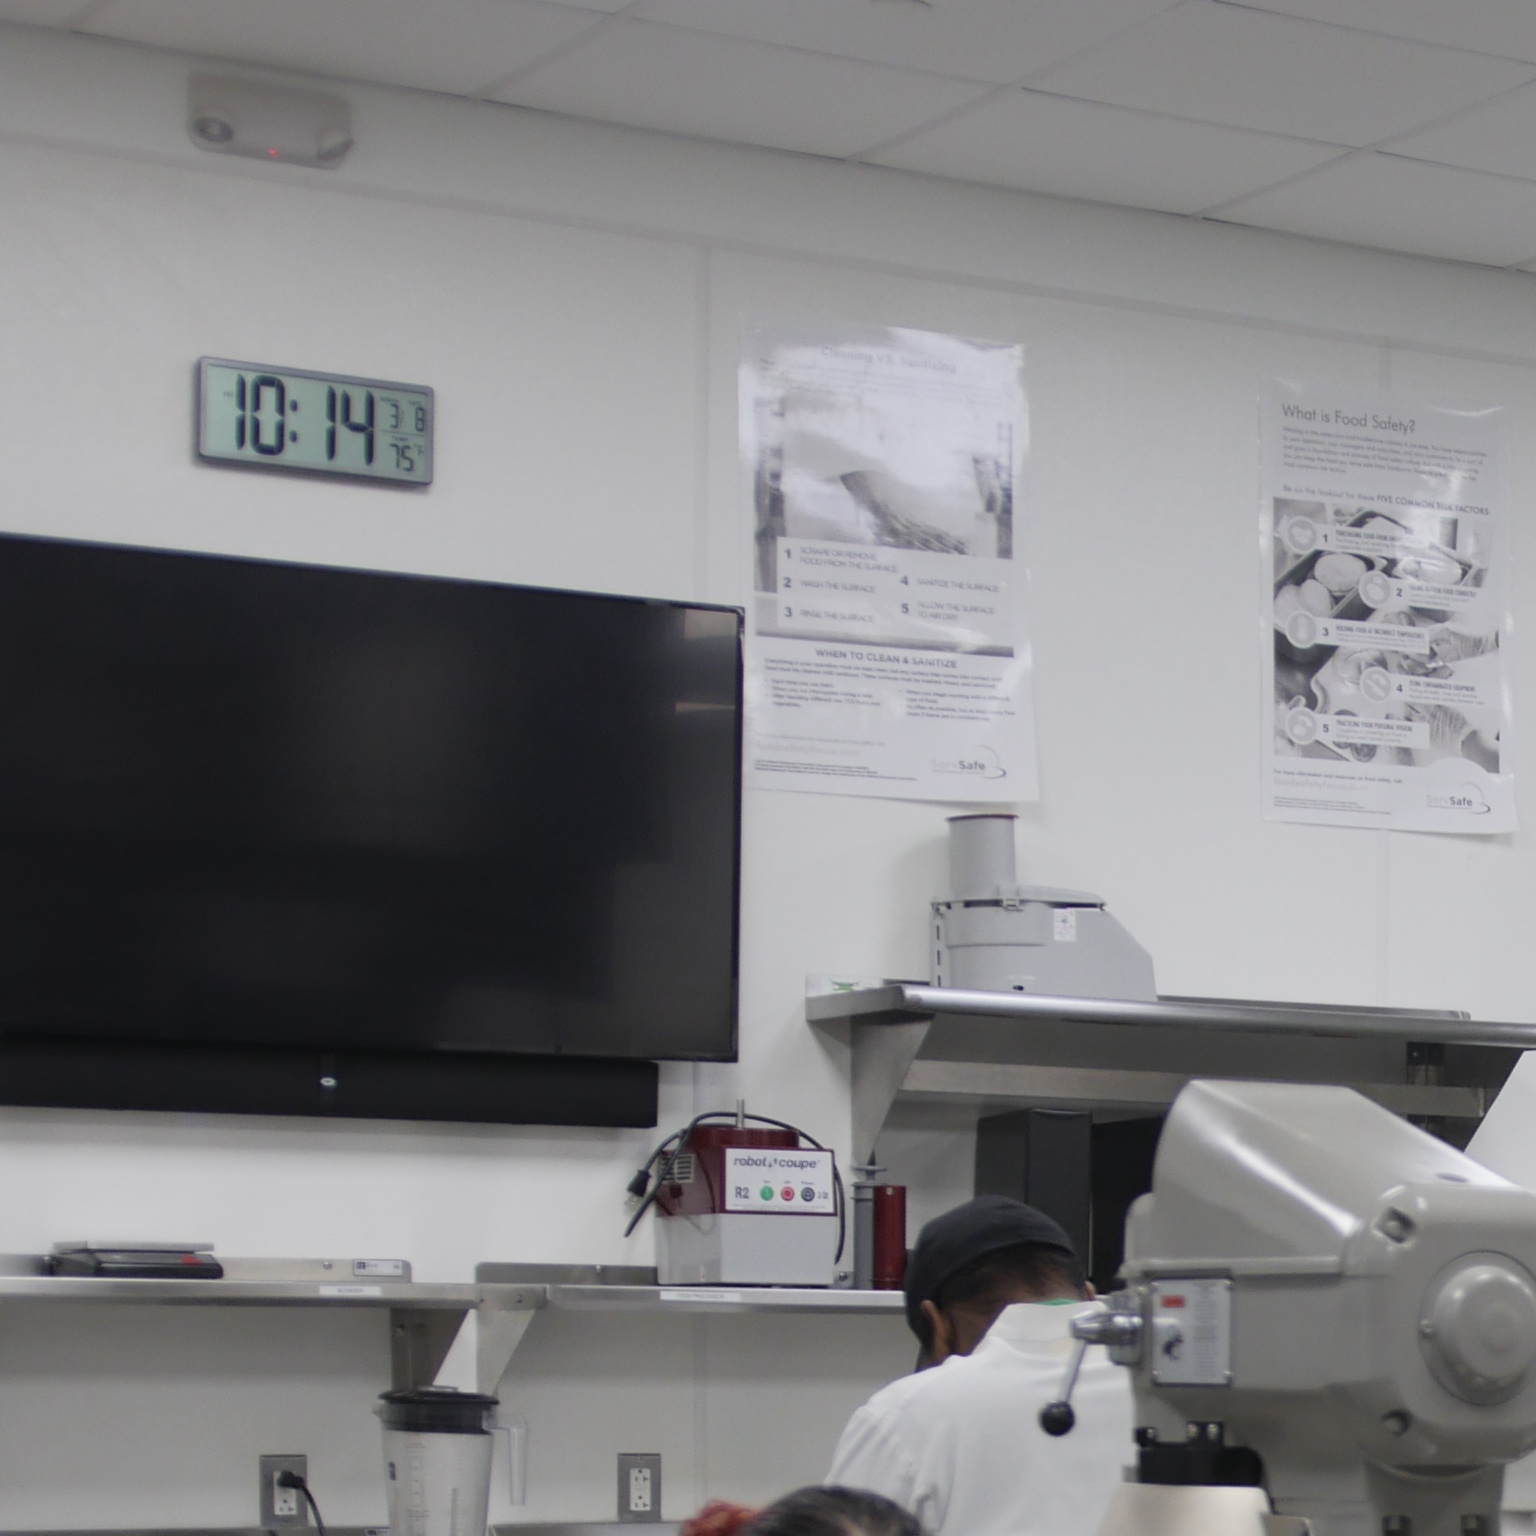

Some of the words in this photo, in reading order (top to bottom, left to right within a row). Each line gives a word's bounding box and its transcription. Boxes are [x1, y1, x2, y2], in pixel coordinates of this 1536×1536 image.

[821, 346, 873, 364] Cleaning
[235, 373, 375, 466] 10:14
[1282, 404, 1316, 421] What
[1321, 409, 1330, 423] is
[1335, 410, 1367, 427] Food
[1372, 414, 1415, 436] Safety?
[1395, 496, 1434, 509] COMMON
[1455, 504, 1489, 515] FACTORS
[1322, 534, 1329, 543] 1
[785, 548, 792, 559] 1
[783, 577, 792, 588] 2
[901, 576, 909, 586] 4
[1396, 588, 1403, 597] 2
[784, 607, 792, 618] 3
[901, 604, 909, 614] 5
[1322, 628, 1329, 637] 3
[816, 649, 848, 659] WHEN
[850, 651, 863, 660] TO
[866, 653, 900, 664] CLEAN
[903, 656, 908, 664] &
[911, 657, 957, 668] SANITIZE
[1396, 685, 1403, 693] 4
[1323, 724, 1329, 732] 5
[733, 1156, 767, 1167] robot
[779, 1159, 817, 1170] coupe
[735, 1186, 749, 1199] R2
